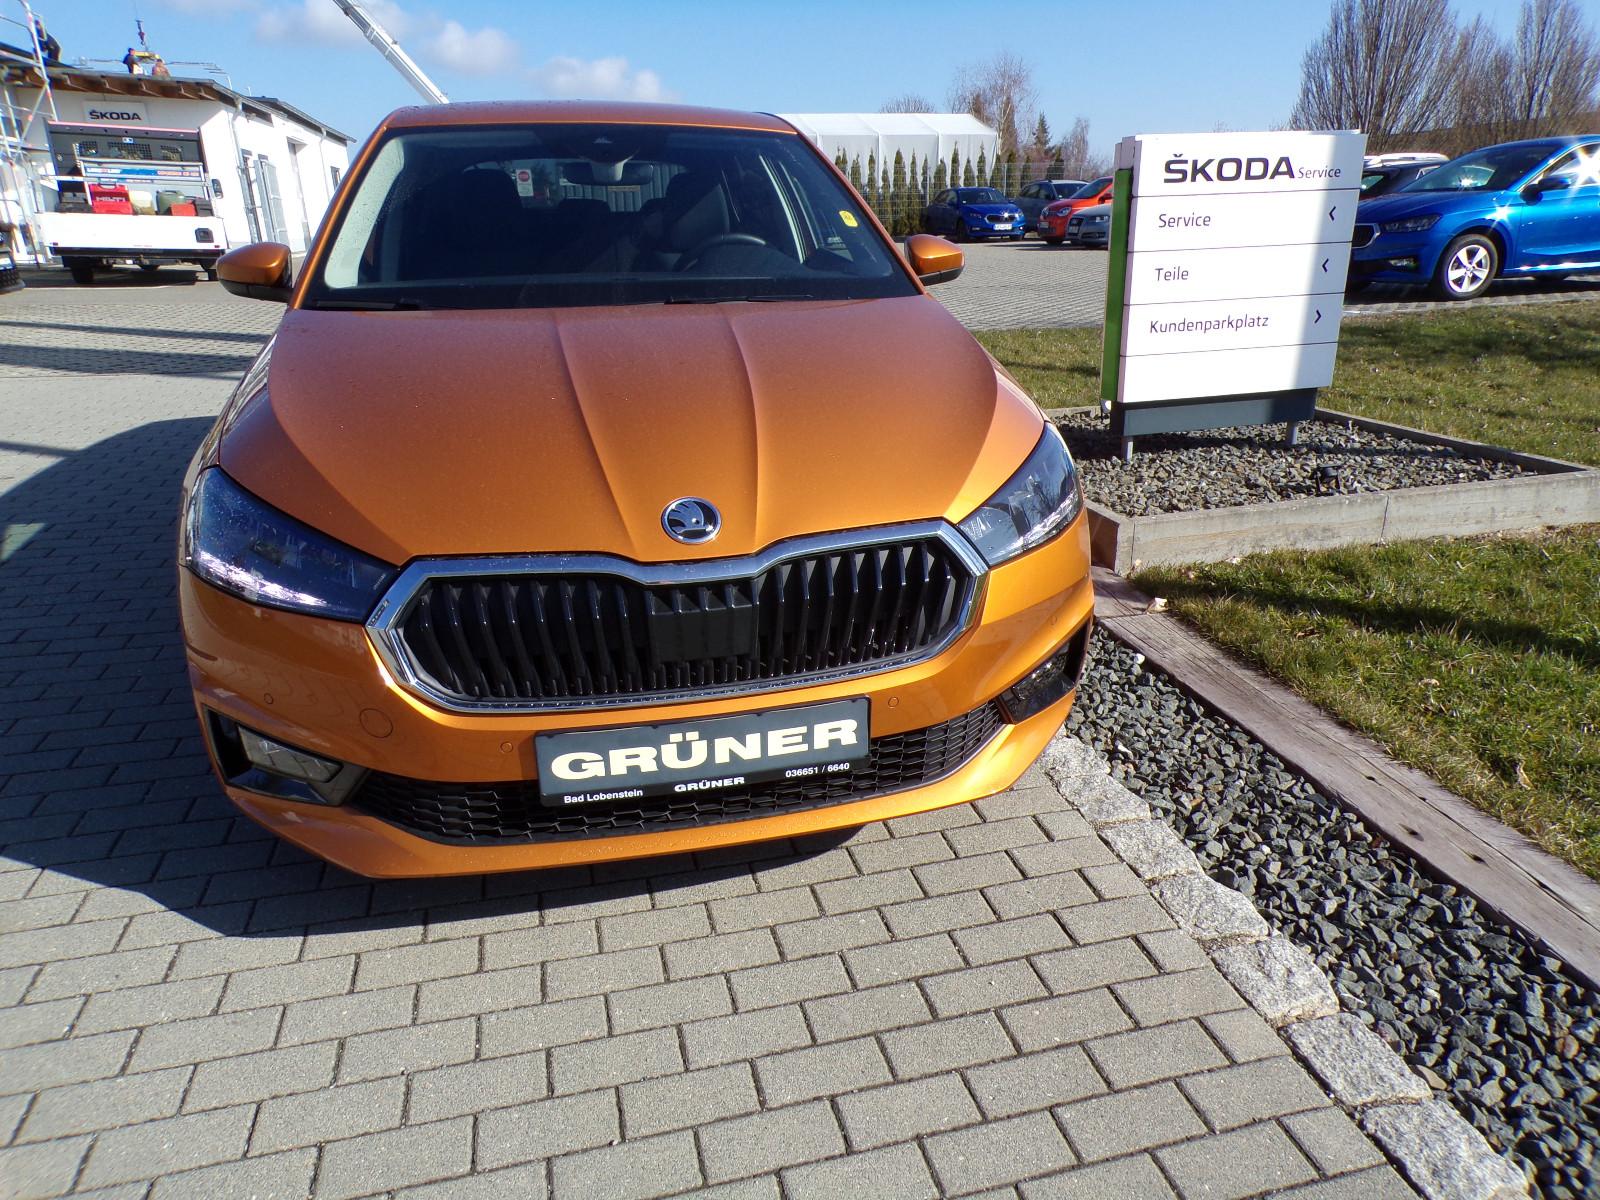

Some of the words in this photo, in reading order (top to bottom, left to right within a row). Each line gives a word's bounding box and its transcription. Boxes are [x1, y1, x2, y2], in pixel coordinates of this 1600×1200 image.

[89, 110, 142, 121] ŠKODA
[1163, 154, 1295, 183] ŠKODA
[1297, 167, 1341, 179] Service
[1158, 212, 1211, 228] Service
[1154, 266, 1189, 281] Teile
[1150, 314, 1269, 333] Kundenparkplatz
[551, 719, 858, 780] GRÜNER
[785, 766, 819, 778] 036651
[827, 762, 850, 773] 6640
[674, 777, 745, 792] GRÜNER
[564, 795, 584, 804] Bad
[586, 789, 643, 802] Lobenstein
